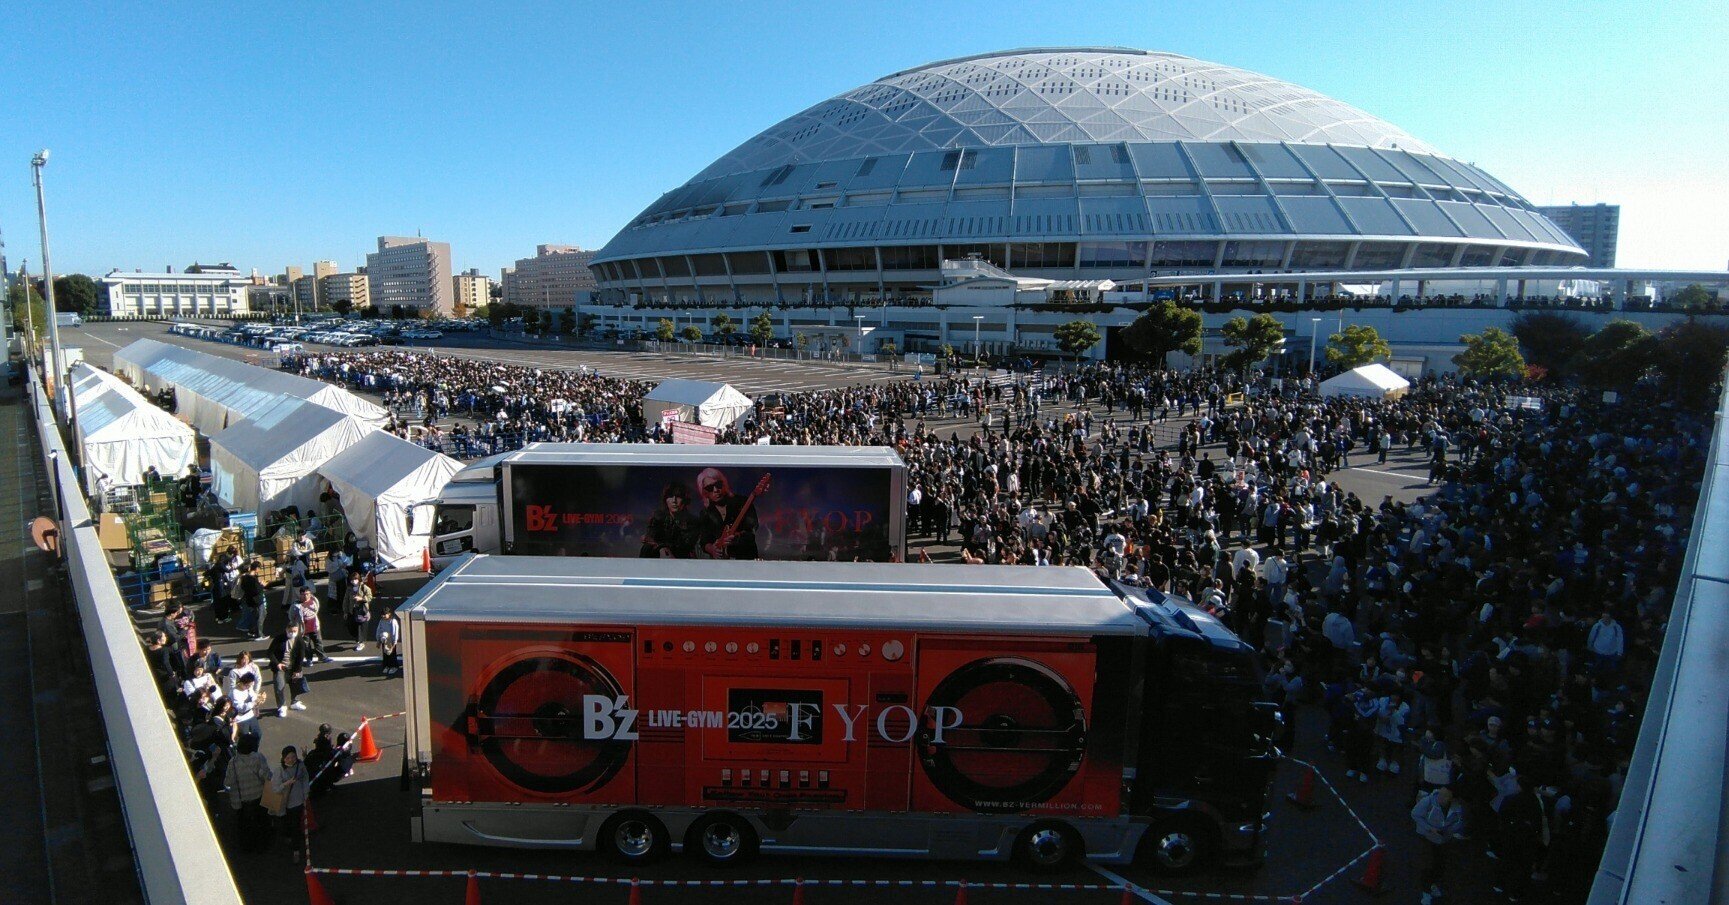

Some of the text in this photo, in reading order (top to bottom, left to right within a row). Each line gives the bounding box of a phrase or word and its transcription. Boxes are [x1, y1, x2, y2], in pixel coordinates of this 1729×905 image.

[526, 504, 558, 532] B'z
[562, 513, 604, 524] LIVE-GYM
[583, 694, 963, 745] B'z LIVE-GYM 2025 FYOP
[974, 800, 1103, 811] WWW.BZ-VERMILLION.COM
